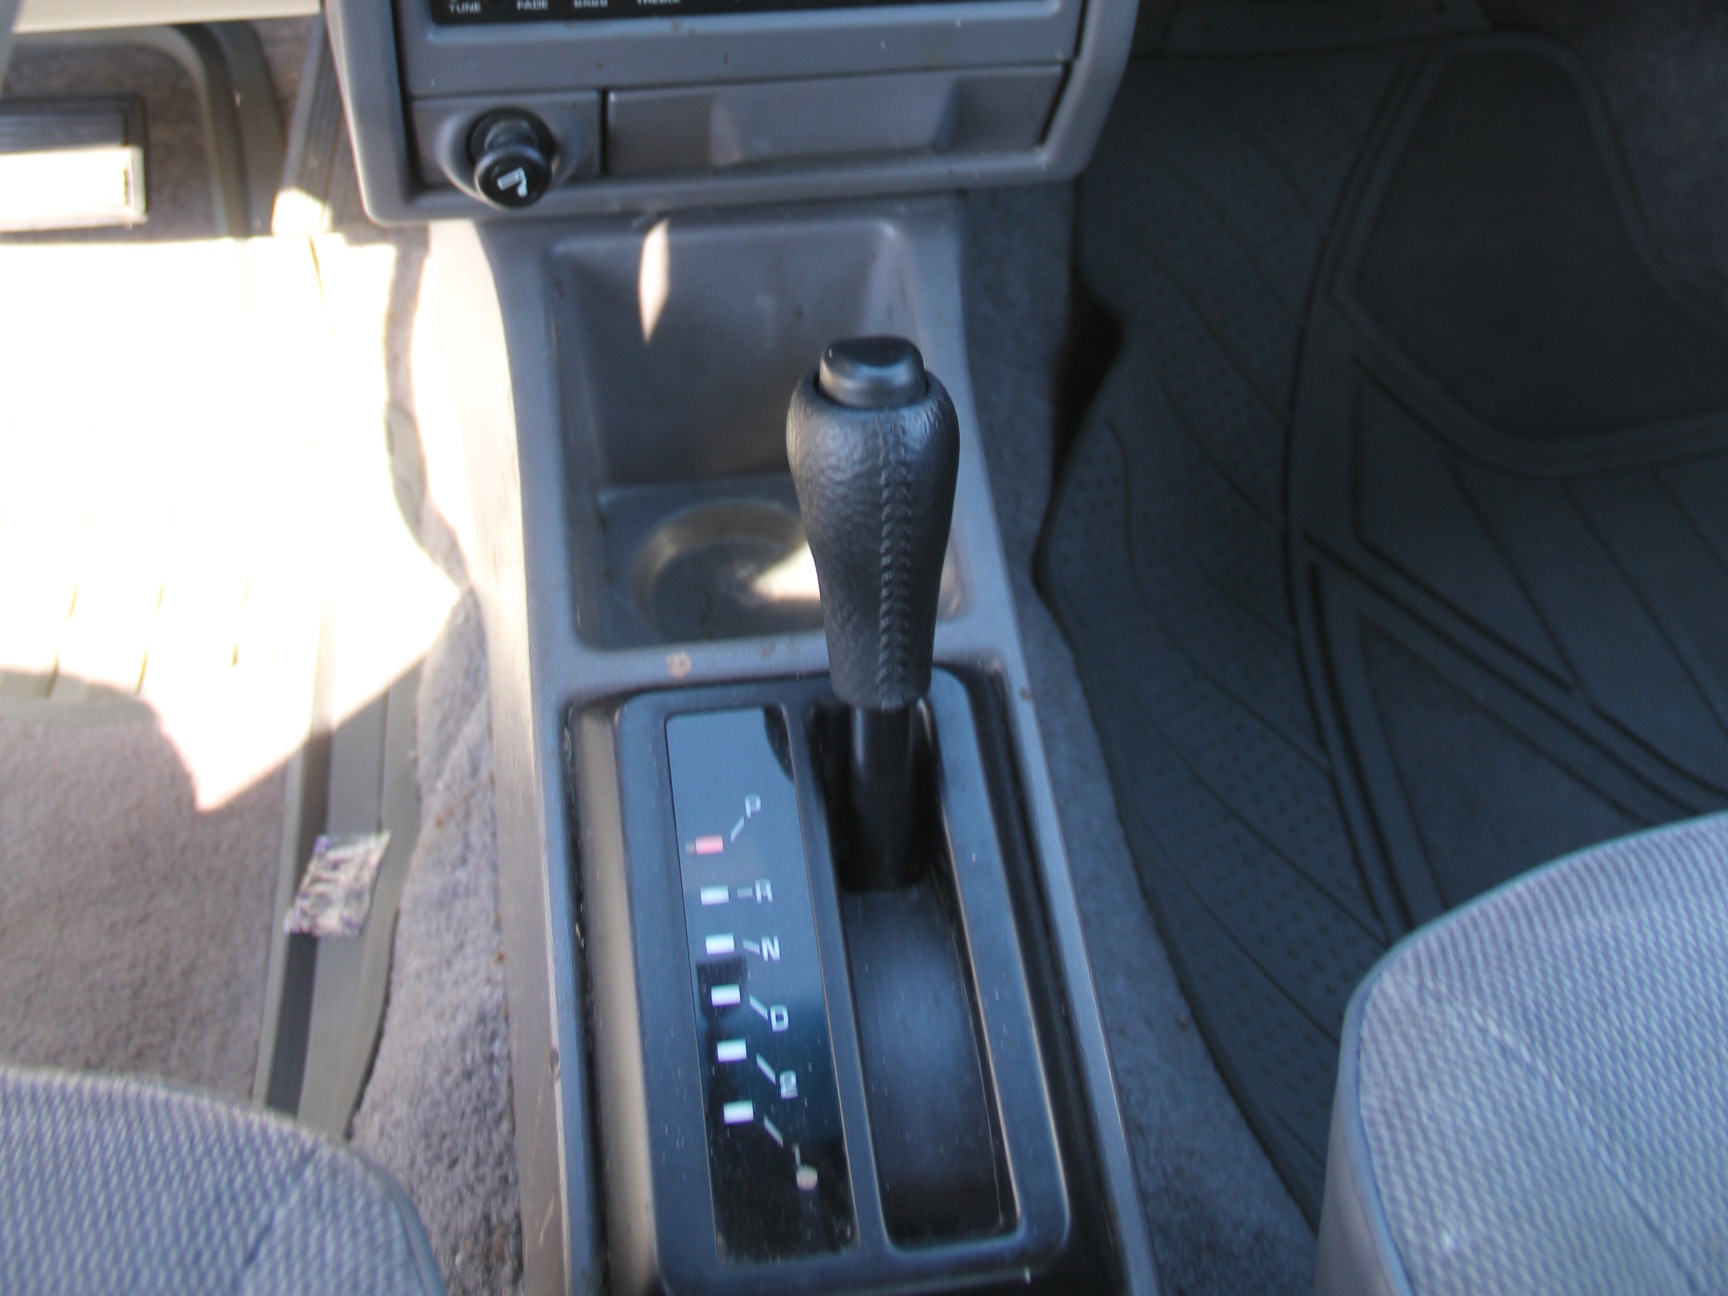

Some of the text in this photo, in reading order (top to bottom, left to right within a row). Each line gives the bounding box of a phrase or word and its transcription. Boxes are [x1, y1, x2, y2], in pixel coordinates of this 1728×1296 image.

[448, 0, 482, 14] TUNE
[745, 794, 761, 818] P
[761, 935, 781, 961] N
[770, 1005, 790, 1032] D
